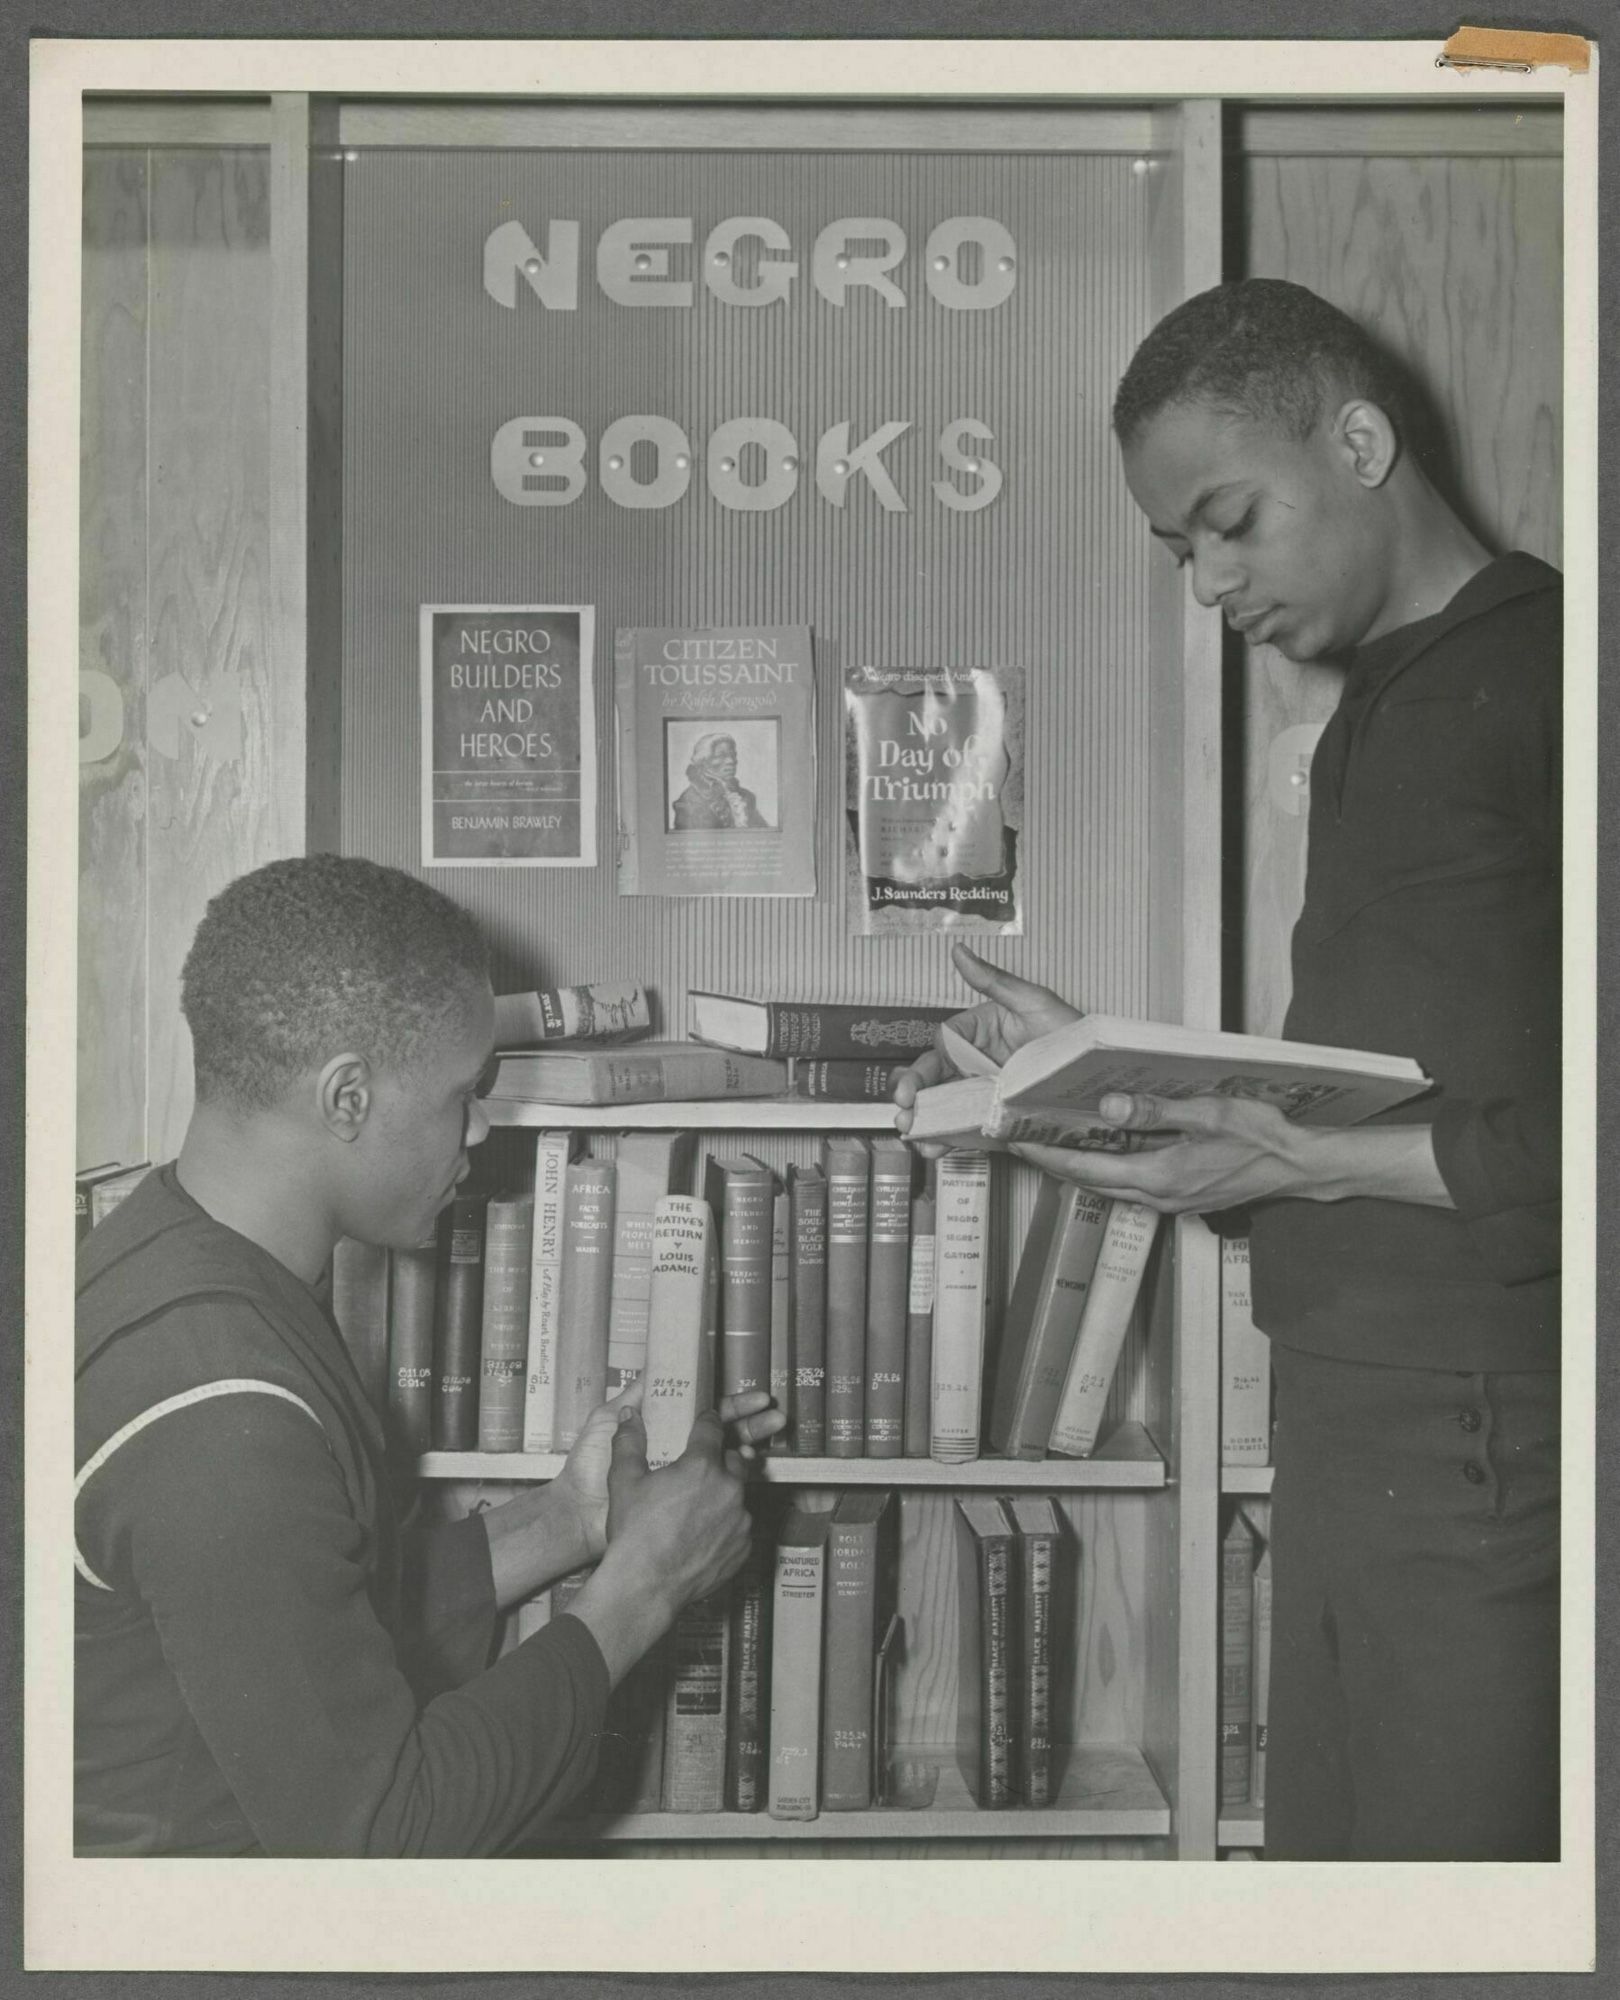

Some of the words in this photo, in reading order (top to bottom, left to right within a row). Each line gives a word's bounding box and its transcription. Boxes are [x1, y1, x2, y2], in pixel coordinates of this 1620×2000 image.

[483, 215, 1017, 310] NEGRO
[490, 413, 1004, 512] BOOKS
[460, 630, 551, 655] NEGRO
[662, 638, 779, 661] CITIZEN
[449, 663, 562, 690] BUILDERS
[642, 663, 799, 686] TOUSSAINT
[479, 698, 533, 724] AND
[679, 691, 716, 712] Ralph
[907, 711, 948, 736] No
[460, 732, 552, 758] HEROES
[877, 739, 936, 775] Day
[867, 772, 997, 811] Triumph
[451, 815, 509, 830] BENJAMIN
[512, 815, 562, 829] BRAWLEY
[884, 886, 946, 900] Saunders
[949, 886, 1009, 904] Redding
[546, 1151, 560, 1197] JOHN
[571, 1184, 611, 1195] AFRICA
[668, 1202, 693, 1212] THE
[1075, 1194, 1106, 1212] BLACK
[625, 1220, 653, 1230] WHEN
[1074, 1208, 1102, 1225] FIRE
[542, 1203, 557, 1257] HENRY
[655, 1228, 703, 1241] RETURN
[659, 1252, 694, 1262] LOUIS
[943, 1251, 980, 1260] GATION
[652, 1264, 699, 1276] ADAMIC
[531, 1374, 550, 1385] 812
[783, 1568, 816, 1577] AFRICA
